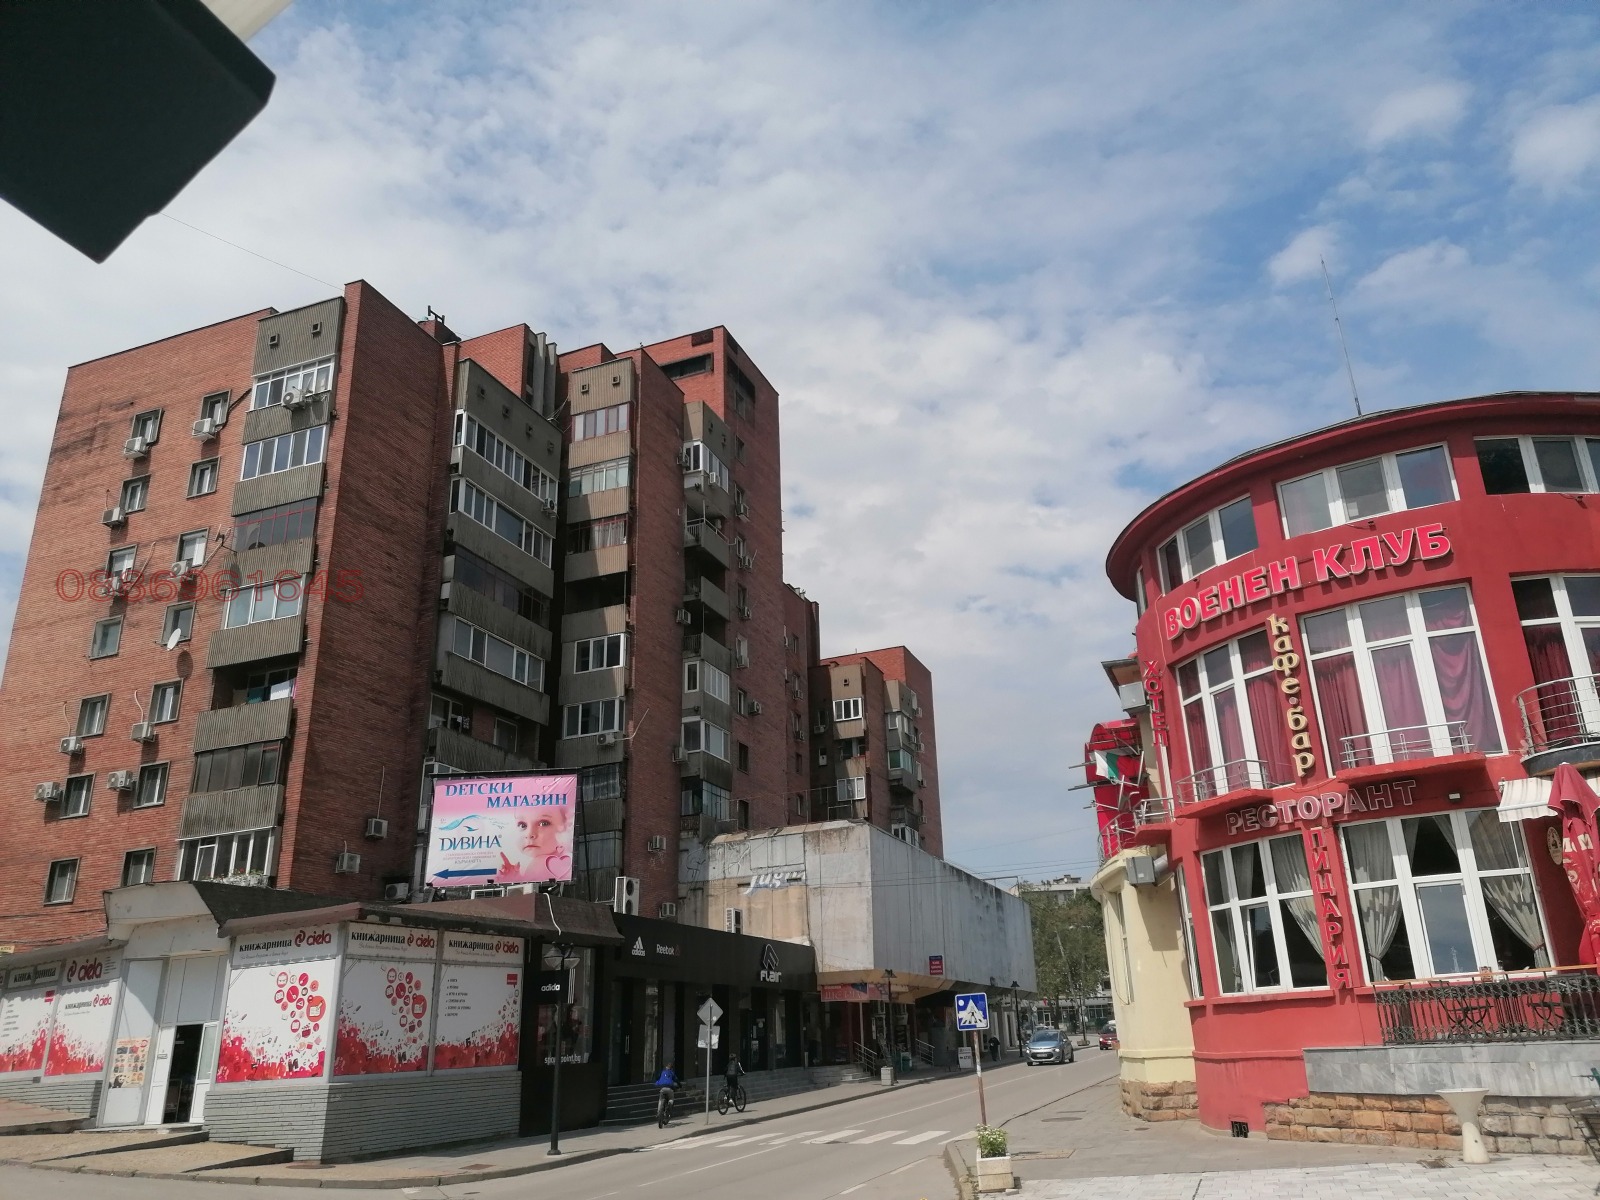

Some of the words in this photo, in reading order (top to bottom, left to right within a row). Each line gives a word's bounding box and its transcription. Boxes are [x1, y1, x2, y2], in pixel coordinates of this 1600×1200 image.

[1164, 555, 1301, 640] ВОЕНЕН
[1312, 522, 1452, 582] КЛУБ
[1143, 660, 1169, 747] ХОТЕЛ
[486, 793, 567, 809] МАГАЗИН
[1225, 779, 1417, 836] РЕСТОРАНТ
[1307, 827, 1351, 989] ПИЦАРИЯ
[239, 939, 293, 953] книжарница
[351, 931, 406, 945] книжарница
[448, 938, 494, 951] книжарница
[656, 943, 675, 956] Reebok
